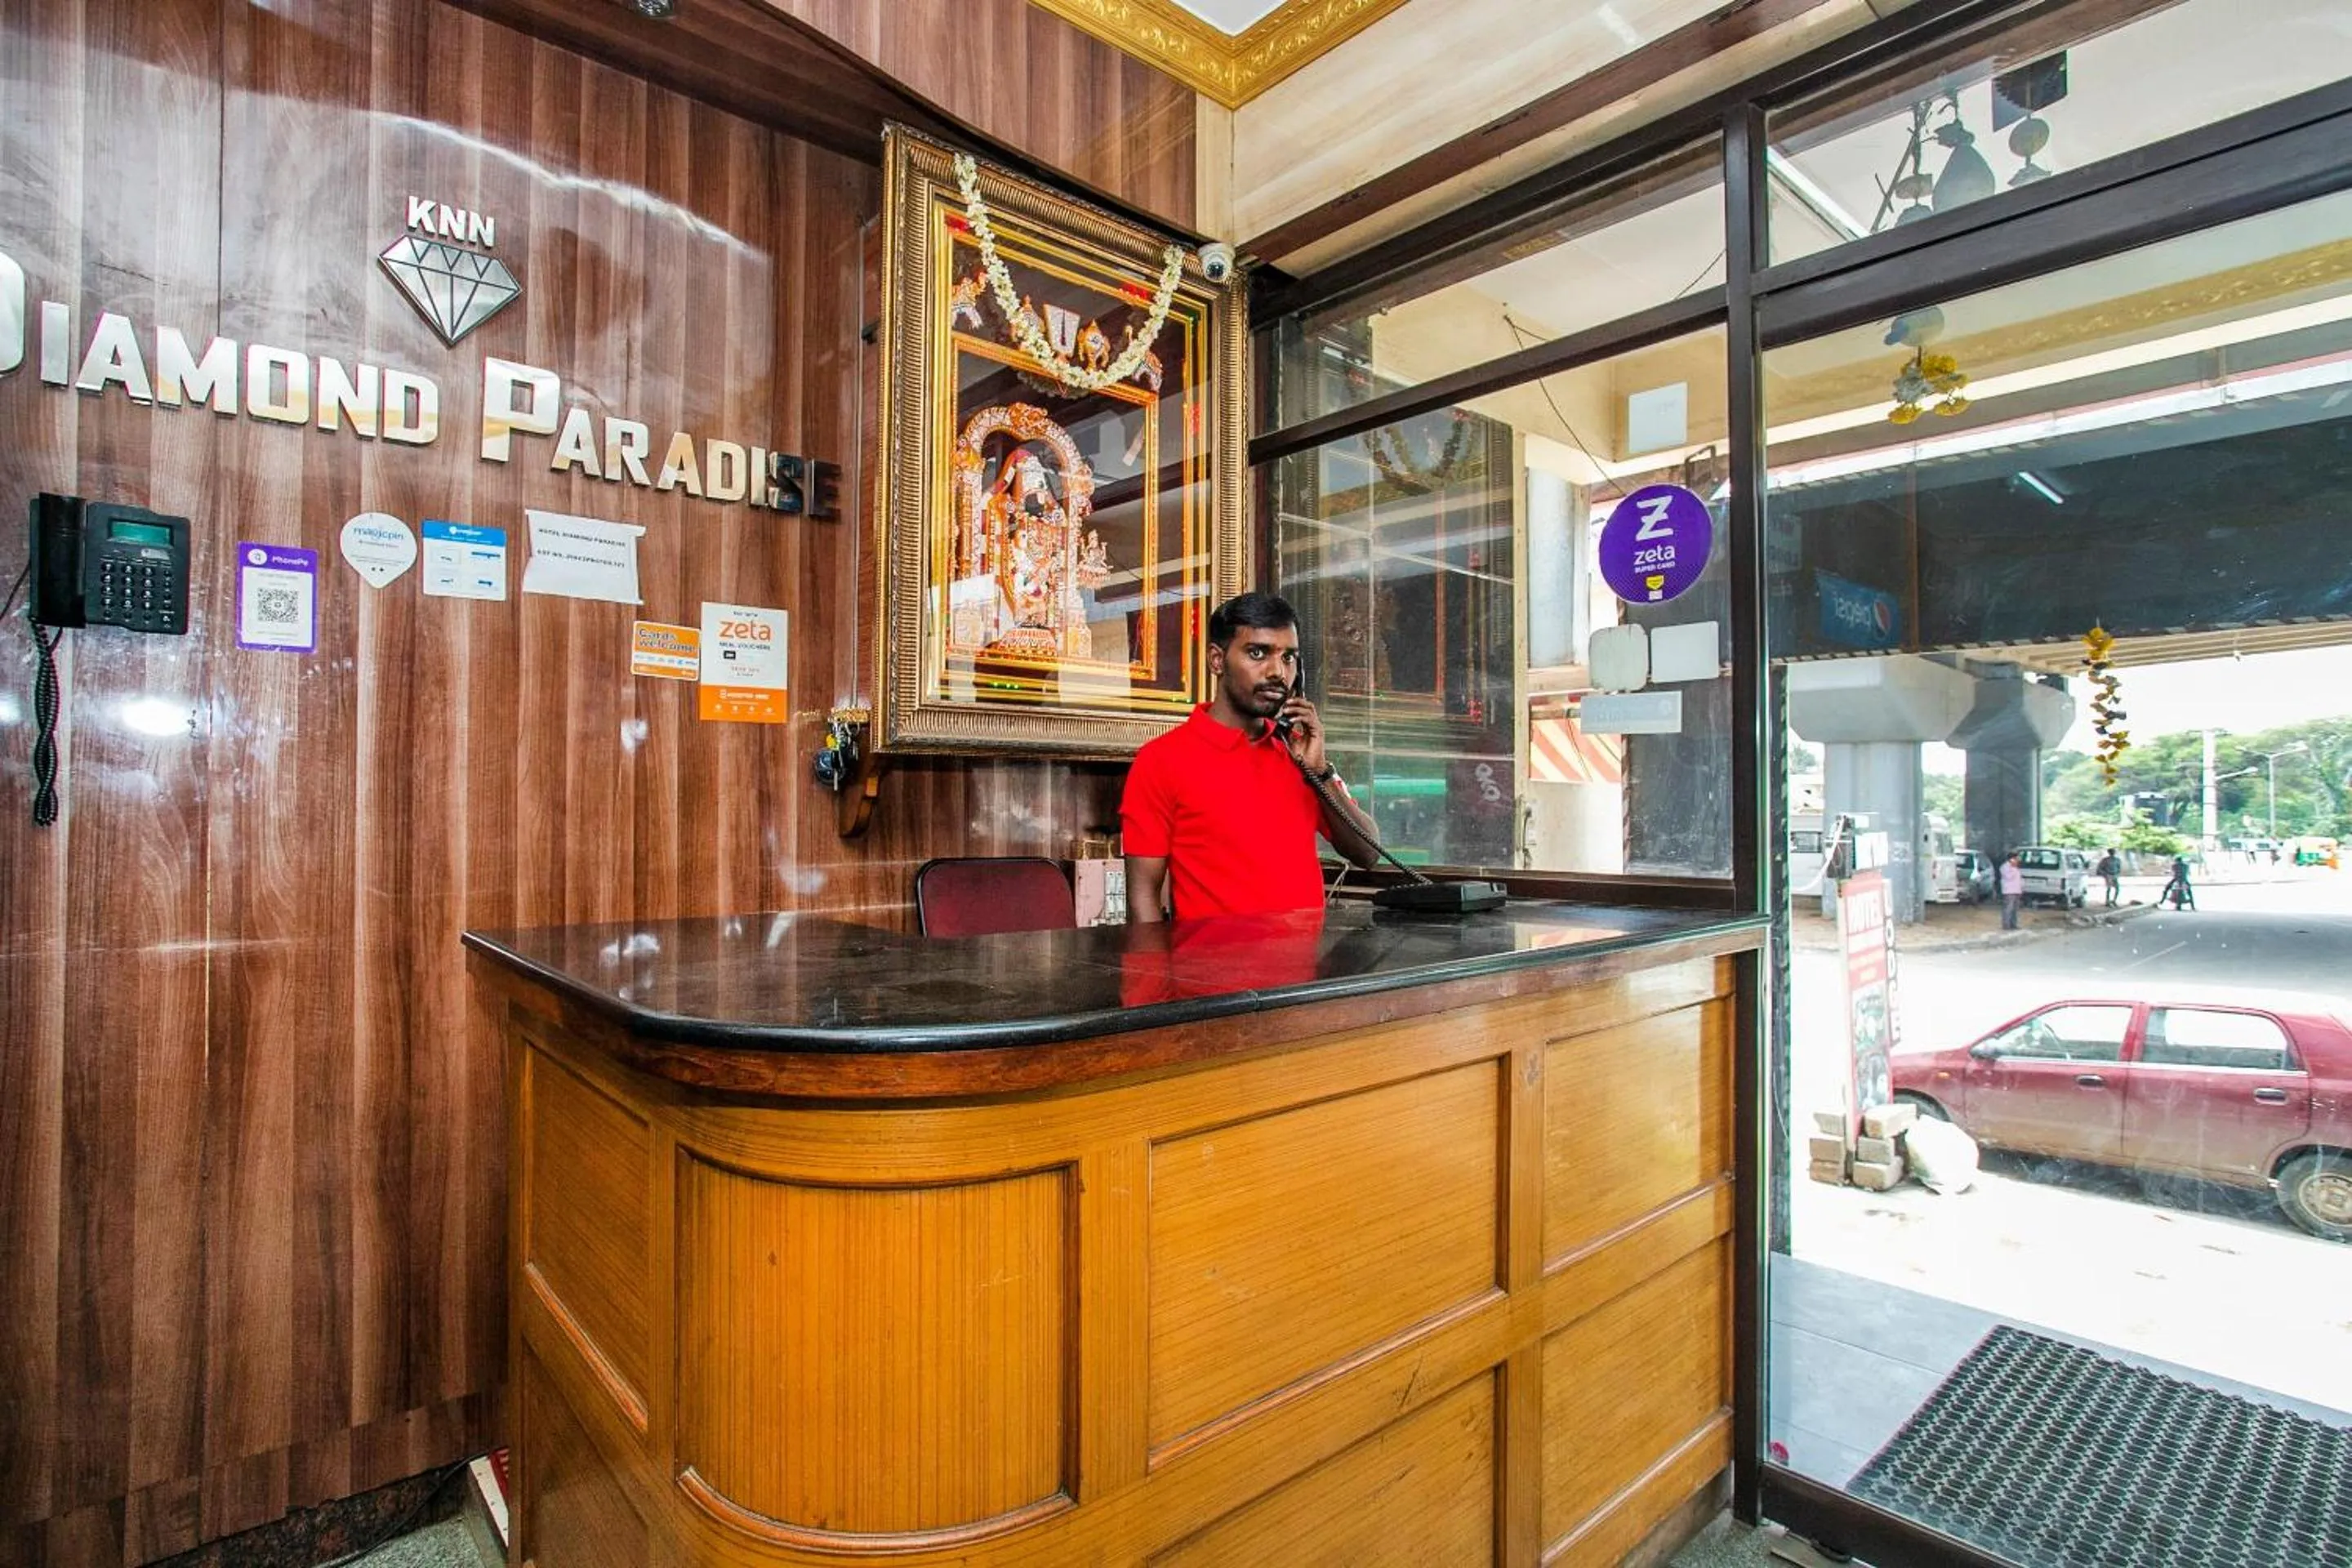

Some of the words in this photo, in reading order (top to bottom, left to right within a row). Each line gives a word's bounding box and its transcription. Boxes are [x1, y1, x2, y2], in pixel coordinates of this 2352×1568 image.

[407, 195, 495, 248] KNN
[0, 252, 439, 446] IAMOND
[480, 356, 840, 518] PARADISE
[354, 527, 404, 541] magicpin
[272, 556, 309, 566] PhonePe
[1633, 544, 1676, 565] zeta
[639, 628, 677, 640] Cards
[719, 619, 771, 642] zeta
